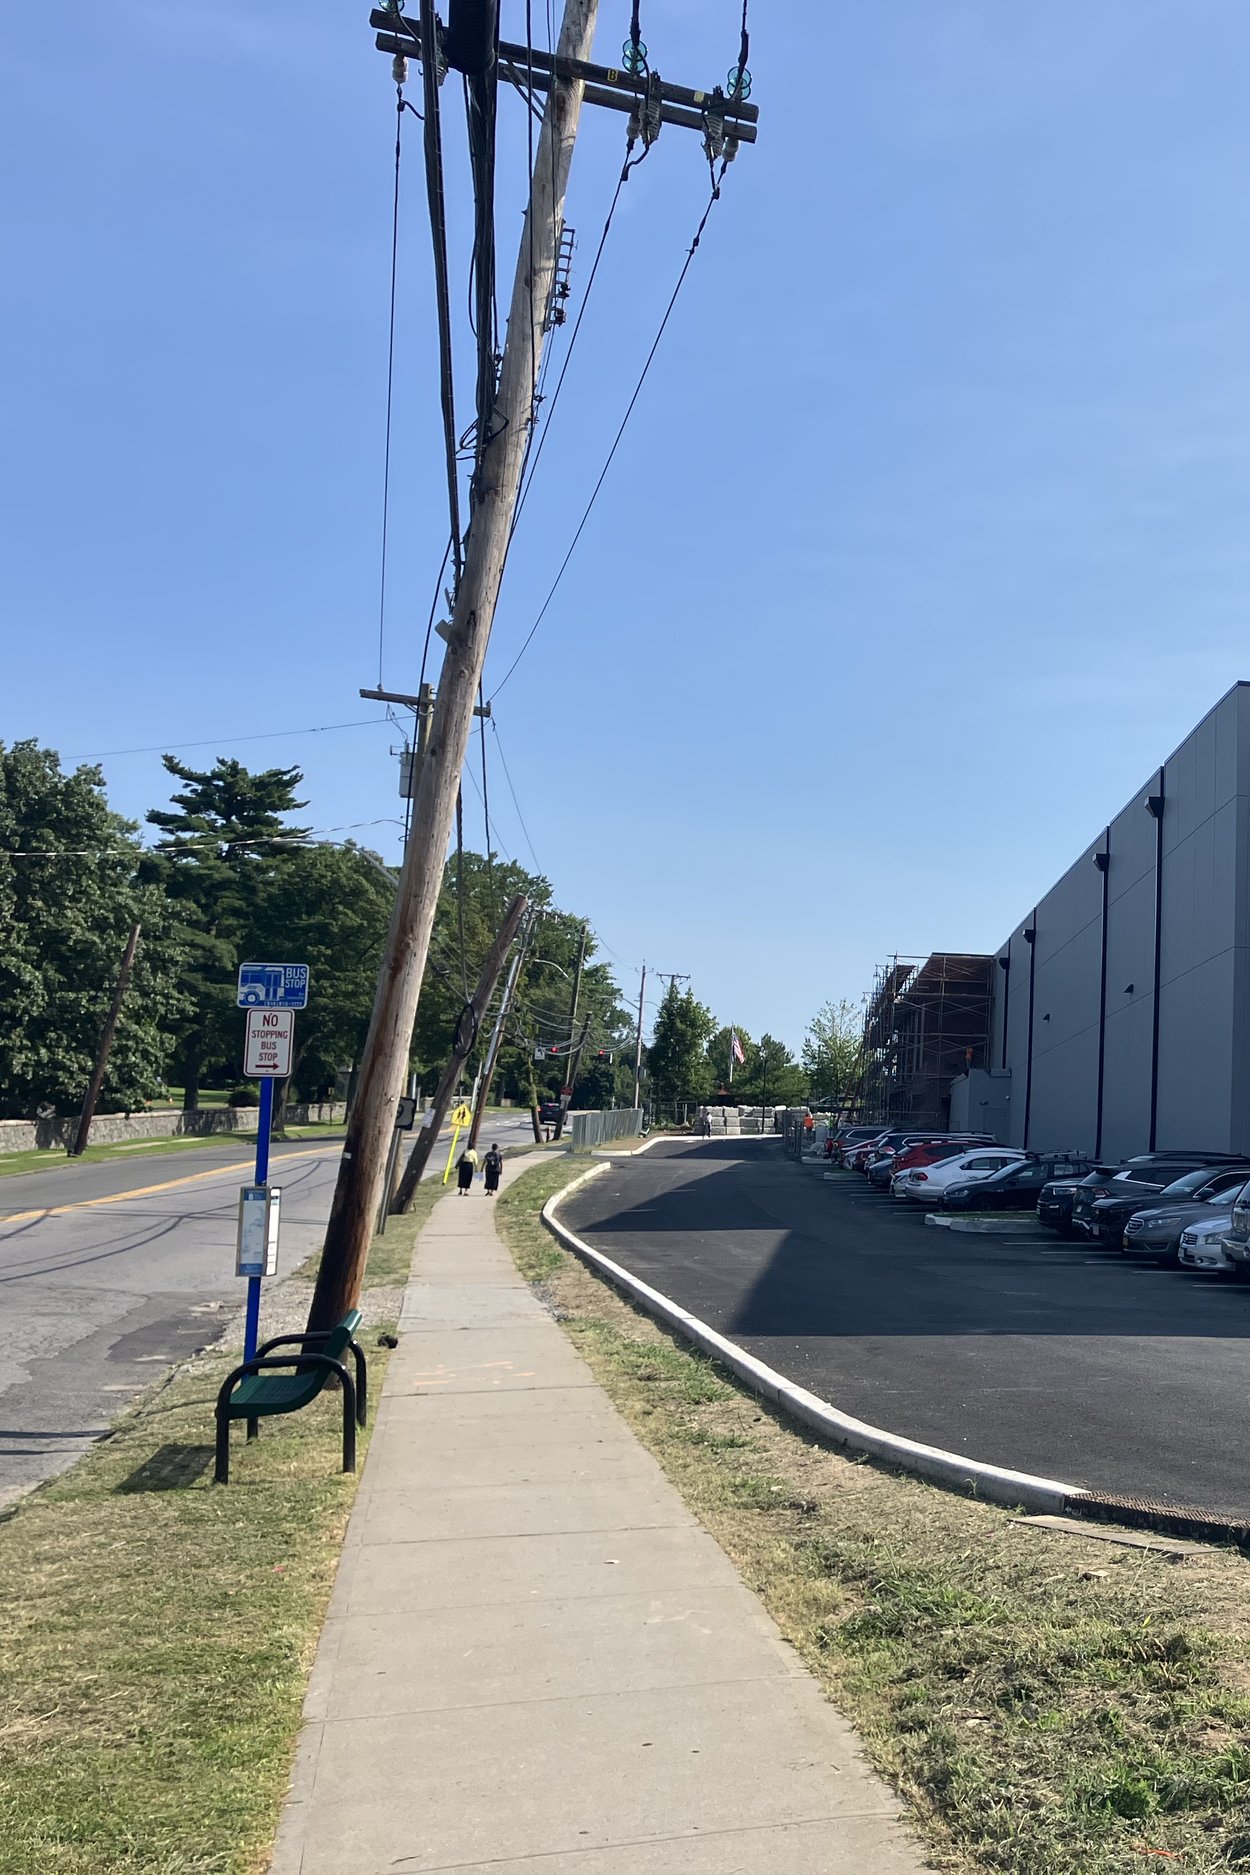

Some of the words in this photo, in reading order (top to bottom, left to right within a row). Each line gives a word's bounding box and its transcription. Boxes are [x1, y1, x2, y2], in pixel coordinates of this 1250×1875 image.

[286, 967, 306, 979] BUS
[284, 979, 306, 989] STOP
[262, 1014, 279, 1027] NO
[251, 1030, 288, 1039] STOPPING
[260, 1041, 277, 1050] BUS
[258, 1052, 278, 1061] STOP
